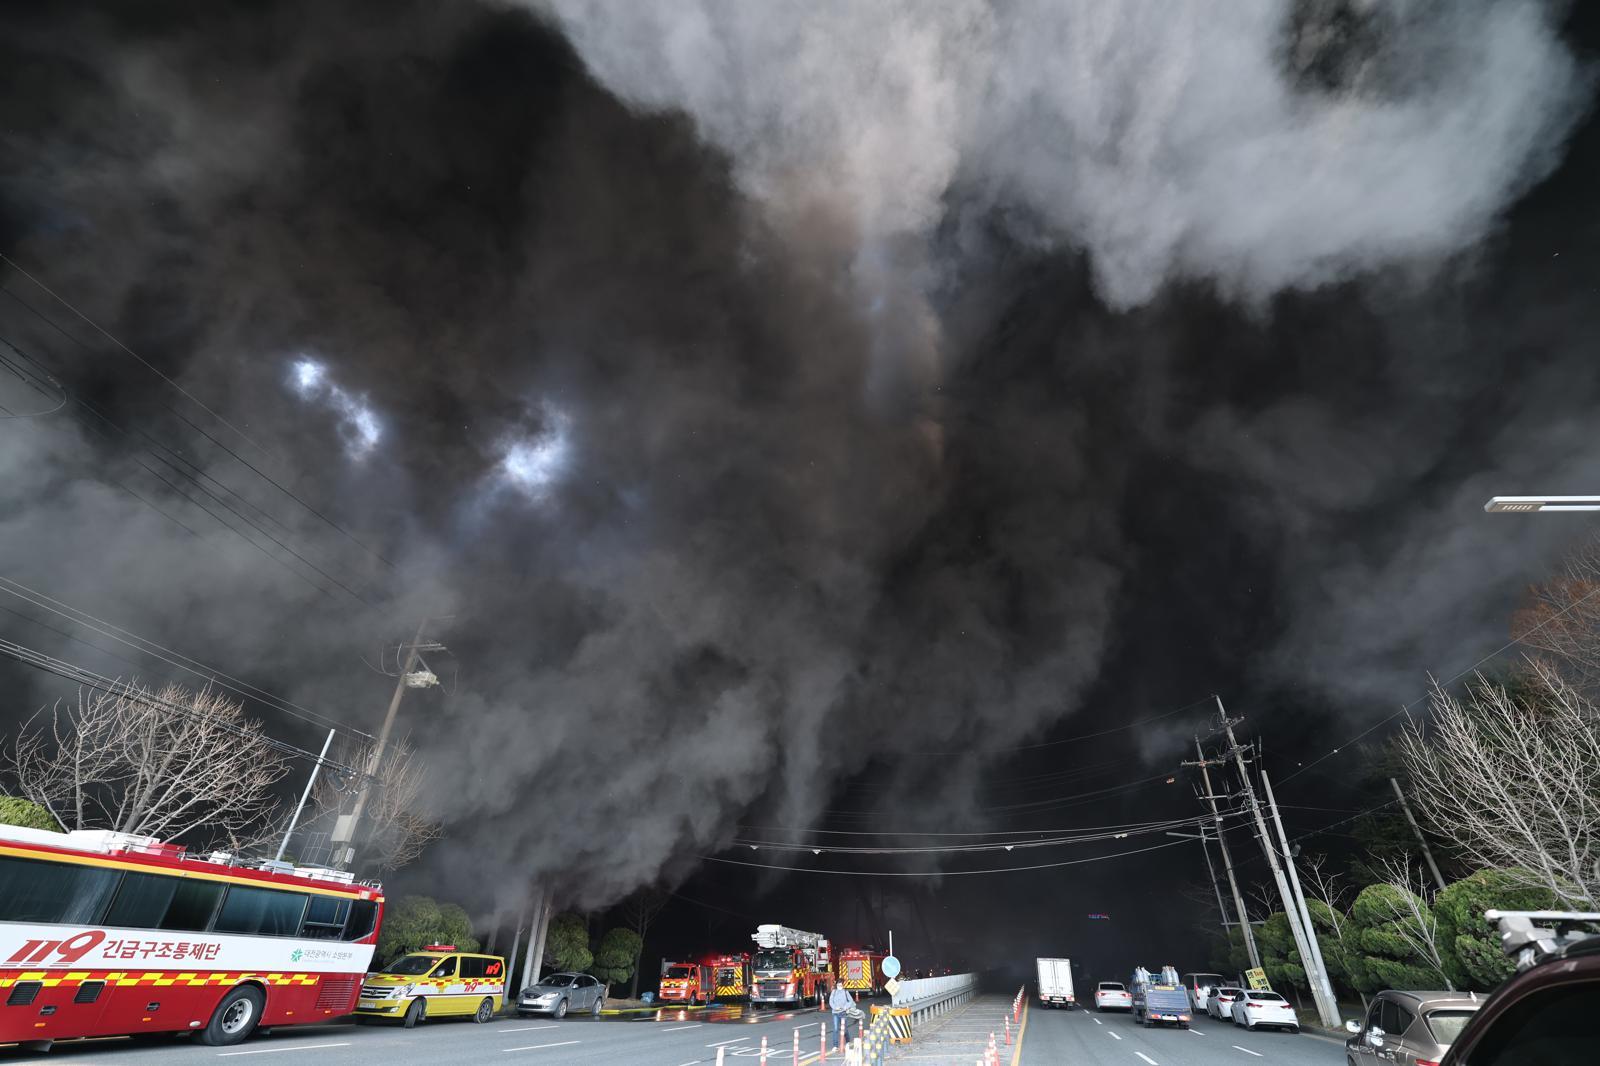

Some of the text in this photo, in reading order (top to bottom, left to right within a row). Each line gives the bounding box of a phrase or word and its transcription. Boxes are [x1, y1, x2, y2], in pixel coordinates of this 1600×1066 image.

[4, 930, 107, 964] 119
[103, 940, 221, 960] 긴급구조통제단
[485, 962, 501, 975] 119
[464, 980, 478, 992] 119
